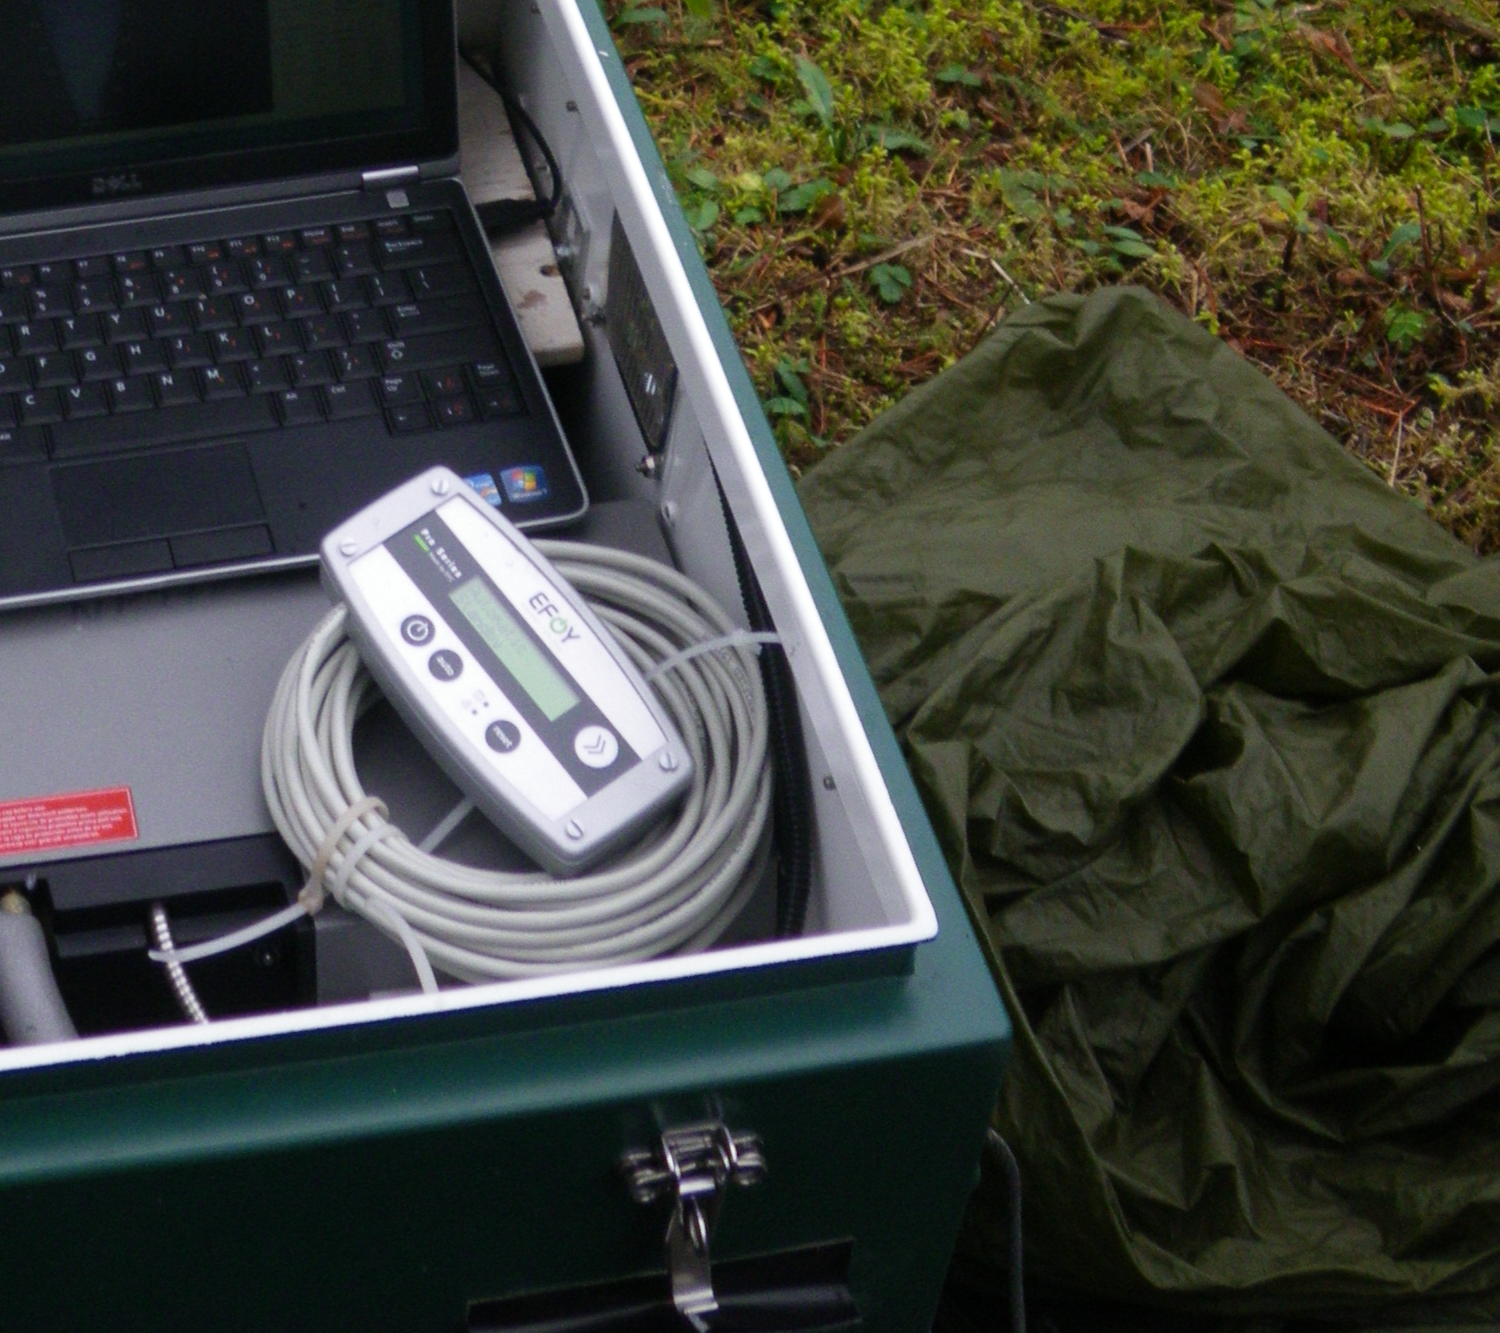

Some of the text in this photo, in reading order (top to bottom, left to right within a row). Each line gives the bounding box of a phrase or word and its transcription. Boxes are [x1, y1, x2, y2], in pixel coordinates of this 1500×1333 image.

[286, 289, 296, 299] P
[243, 295, 255, 305] O
[154, 307, 165, 318] U
[66, 319, 75, 330] T
[111, 314, 120, 324] Y
[20, 325, 30, 336] R
[264, 327, 272, 337] L
[218, 332, 229, 342] K
[176, 339, 183, 349] J
[85, 350, 97, 361] G
[129, 345, 141, 355] H
[206, 368, 220, 379] M
[162, 375, 174, 385] N
[116, 381, 126, 392] B
[70, 388, 81, 398] V
[25, 394, 36, 405] C
[420, 528, 436, 547] Pro
[436, 546, 463, 579] Series
[529, 591, 581, 643] EFOY
[436, 655, 455, 677] auto
[492, 725, 513, 749] reset
